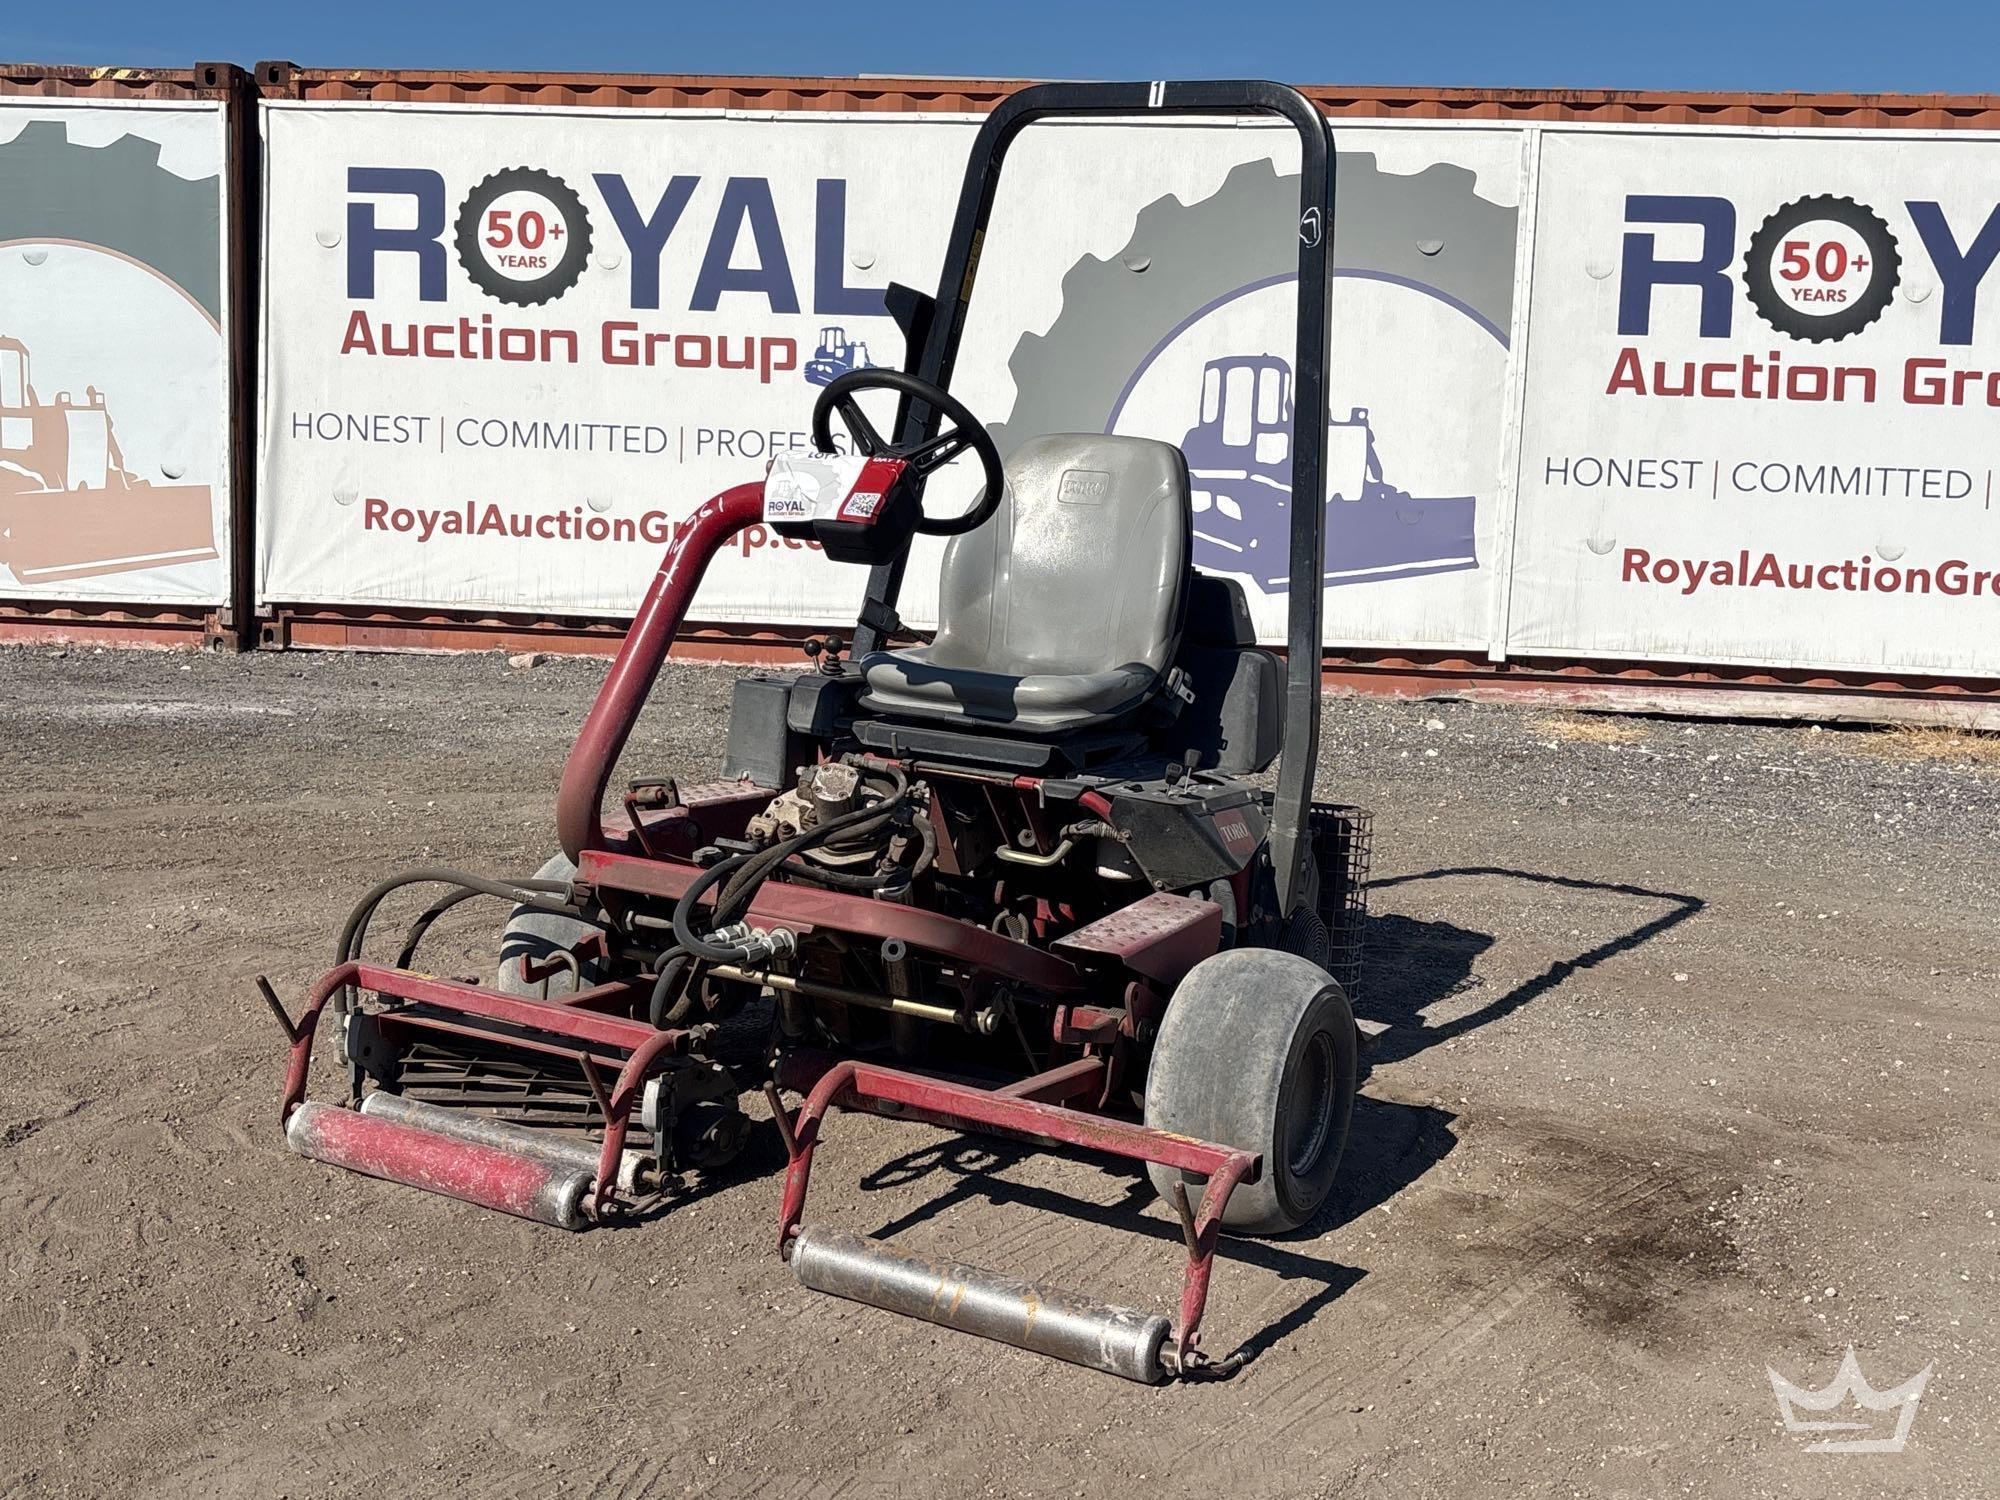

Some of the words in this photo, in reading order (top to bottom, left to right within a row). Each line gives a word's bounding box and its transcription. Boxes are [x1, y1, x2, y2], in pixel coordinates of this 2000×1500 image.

[485, 211, 565, 249] 50+
[497, 254, 548, 270] YEARS
[1778, 241, 1870, 282] 50+
[1790, 287, 1847, 304] YEARS
[341, 310, 578, 363] Auction
[601, 320, 797, 384] Group
[1605, 347, 1876, 403] Auction
[292, 411, 430, 444] HONEST
[456, 418, 667, 454] COMMITTED
[1545, 456, 1703, 490] HONEST
[1732, 461, 1972, 499] COMMITTED
[768, 500, 806, 512] ROYAL
[1220, 821, 1248, 843] TORO
